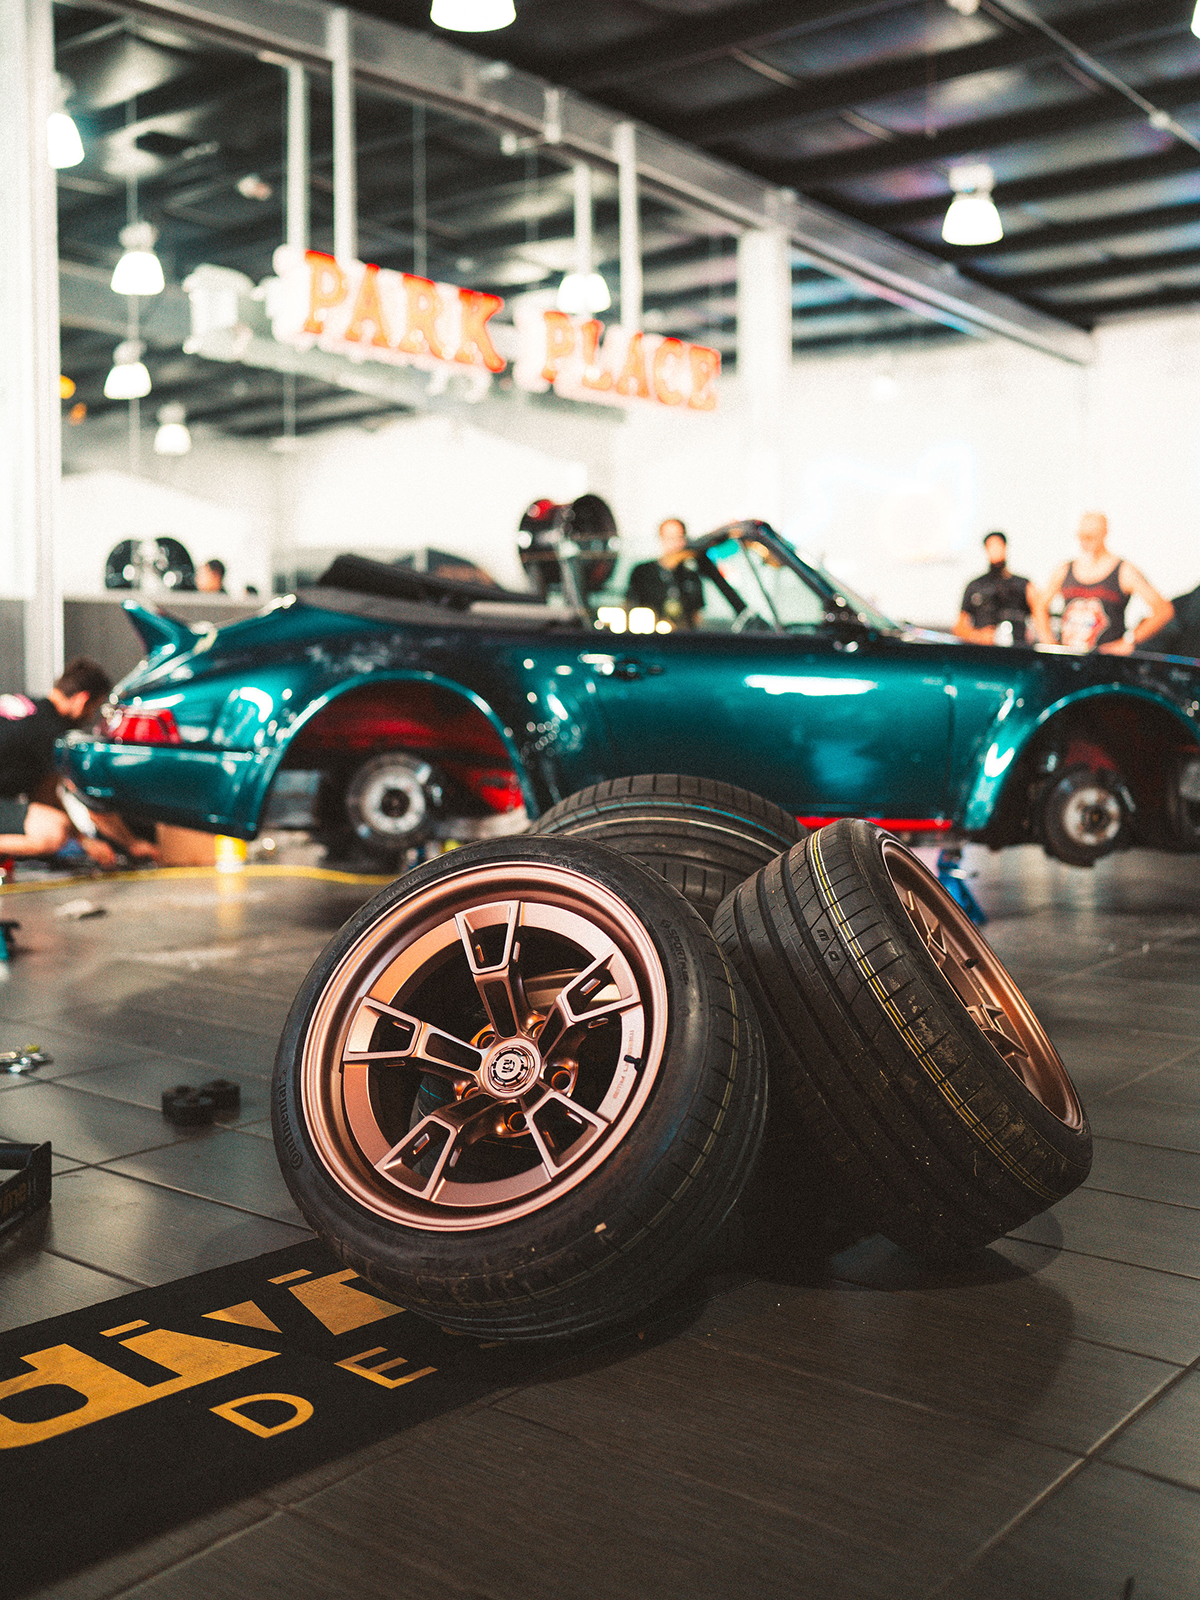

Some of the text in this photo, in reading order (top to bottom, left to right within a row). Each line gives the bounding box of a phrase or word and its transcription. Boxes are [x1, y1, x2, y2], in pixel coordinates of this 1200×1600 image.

[304, 249, 723, 412] PARK PLACE
[0, 1182, 27, 1215] ine
[209, 1346, 438, 1439] DE
